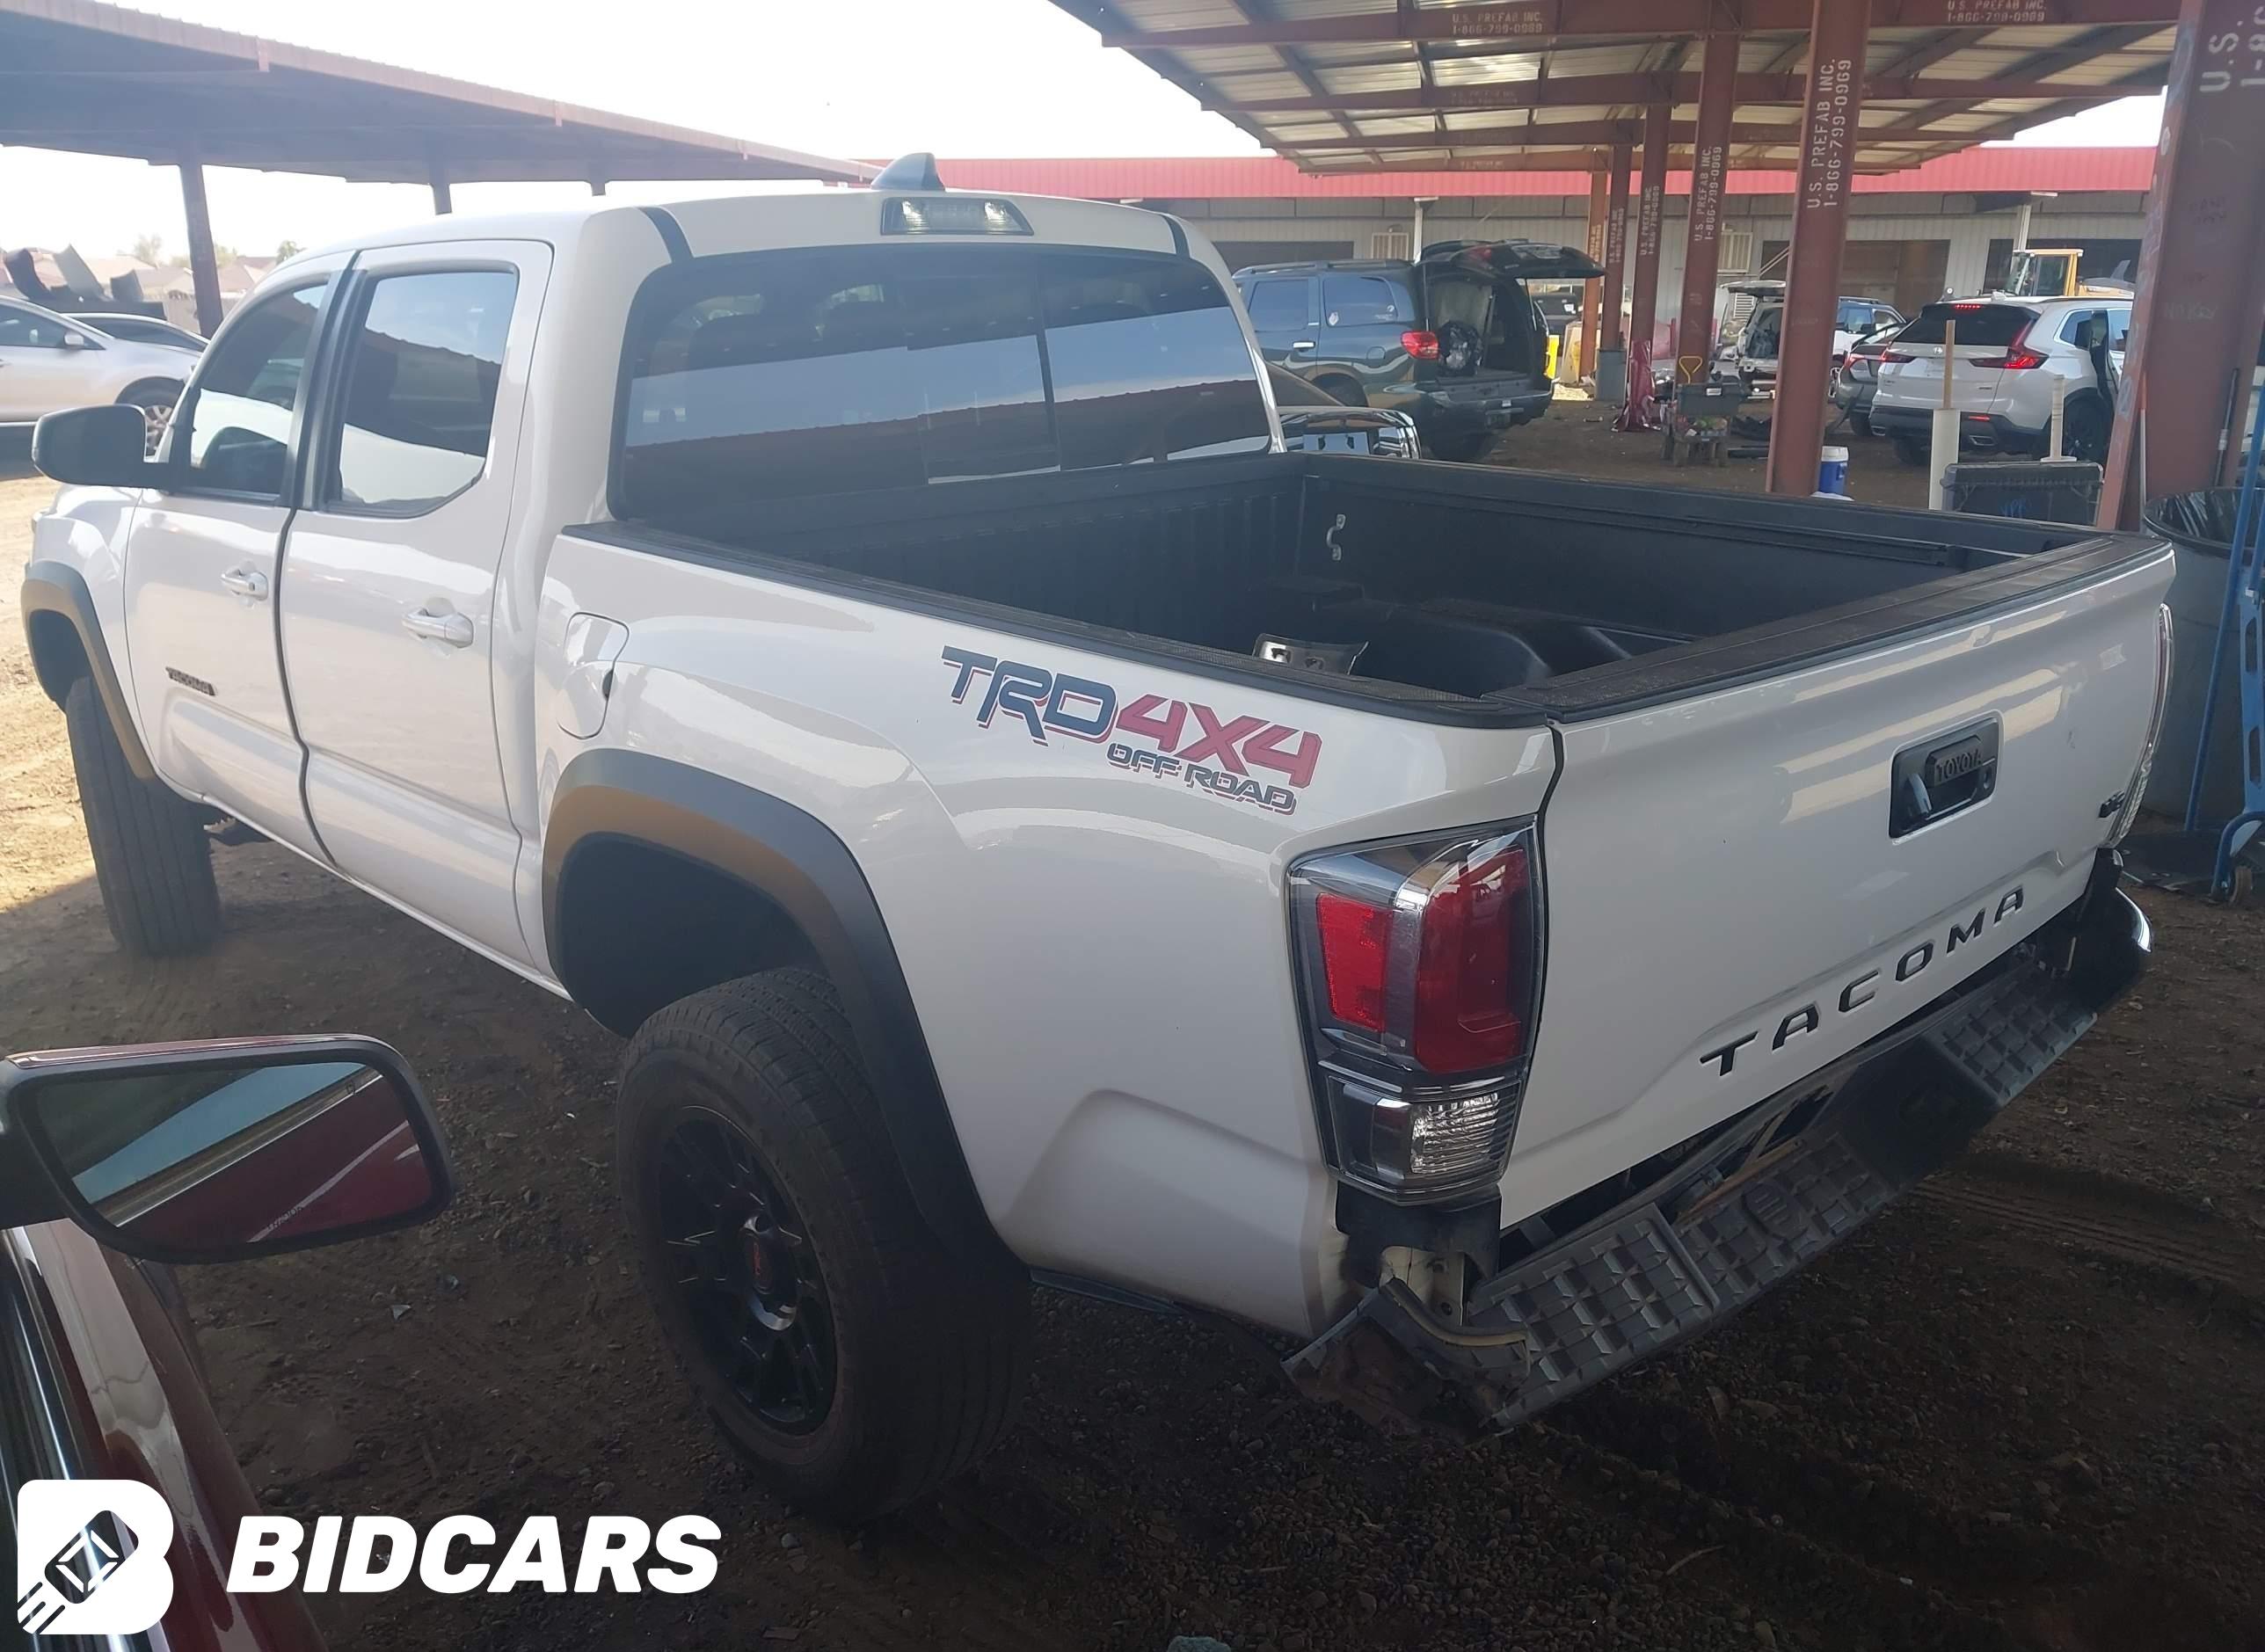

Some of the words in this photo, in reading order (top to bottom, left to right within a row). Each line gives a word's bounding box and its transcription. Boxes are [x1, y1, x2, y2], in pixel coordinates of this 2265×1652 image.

[1975, 0, 2021, 10] PREFAB
[1818, 59, 1835, 91] INC.
[2199, 21, 2243, 92] U.S.
[1810, 100, 1831, 167] PREFAB
[1824, 59, 1852, 206] 1-866-799-0969
[1696, 172, 1708, 215] PREFAB
[1807, 177, 1824, 208] U.S.
[941, 645, 1118, 746] TRD
[1115, 694, 1323, 789] 4X4
[1106, 742, 1183, 778] OFF
[1183, 762, 1298, 816] ROAD
[1934, 748, 1982, 783] TOYOTA
[1700, 884, 2024, 1077] TACOMA
